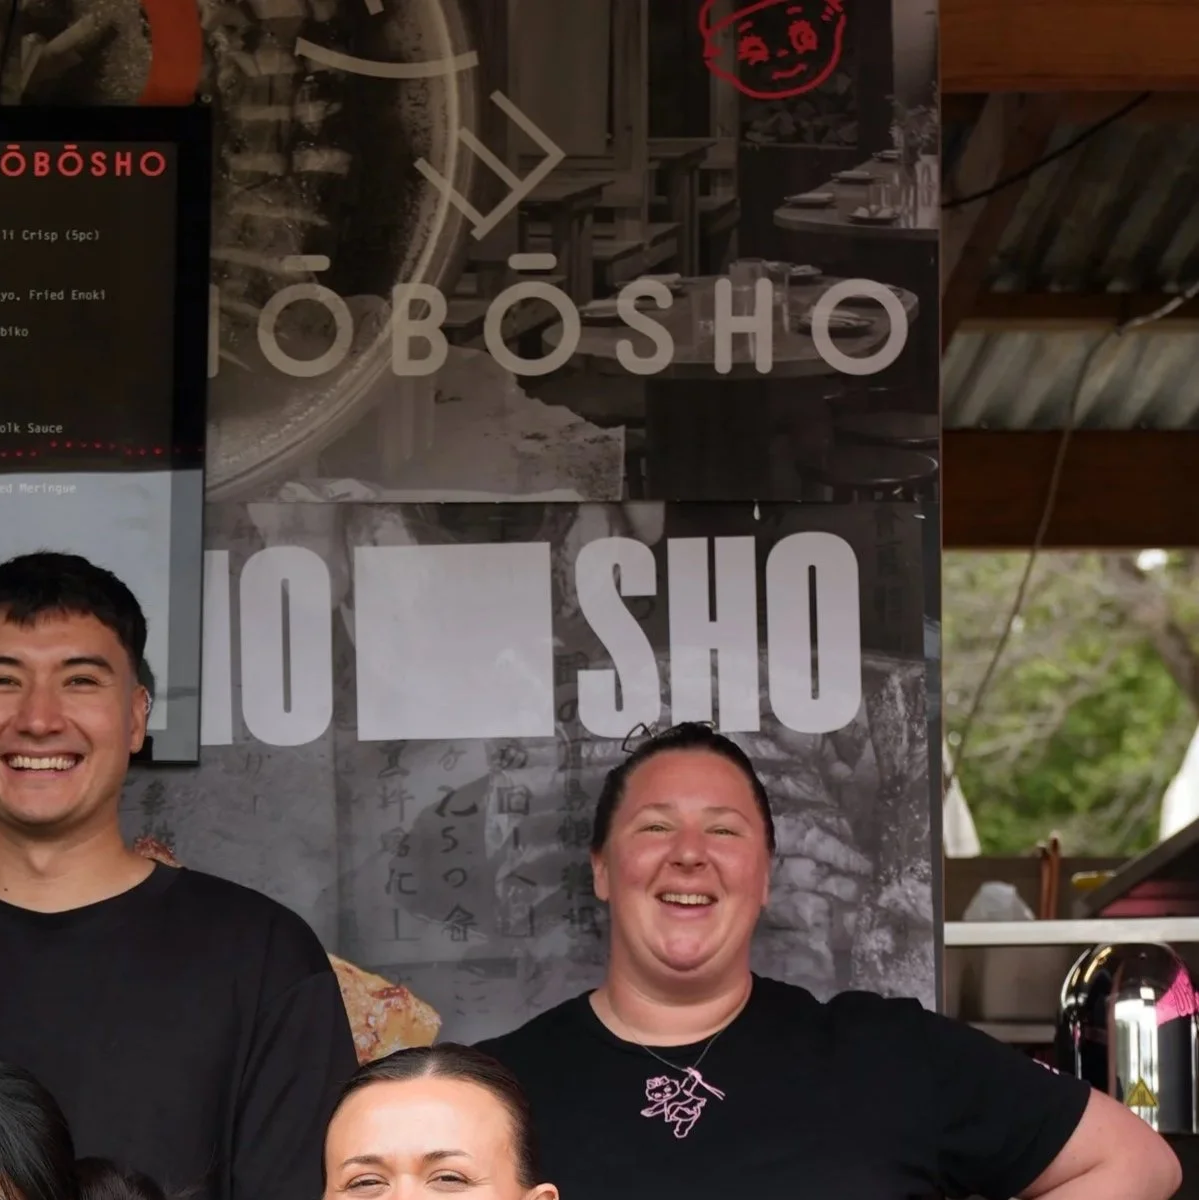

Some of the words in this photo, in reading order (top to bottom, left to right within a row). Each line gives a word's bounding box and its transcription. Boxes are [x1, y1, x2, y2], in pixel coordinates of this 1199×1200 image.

[22, 229, 58, 243] Crisp
[66, 229, 100, 243] (5pc)
[29, 289, 65, 301] Fried
[72, 289, 106, 301] Enoki
[208, 253, 909, 378] ŌBŌSHO
[28, 422, 63, 434] Sauce
[575, 532, 862, 738] SHO
